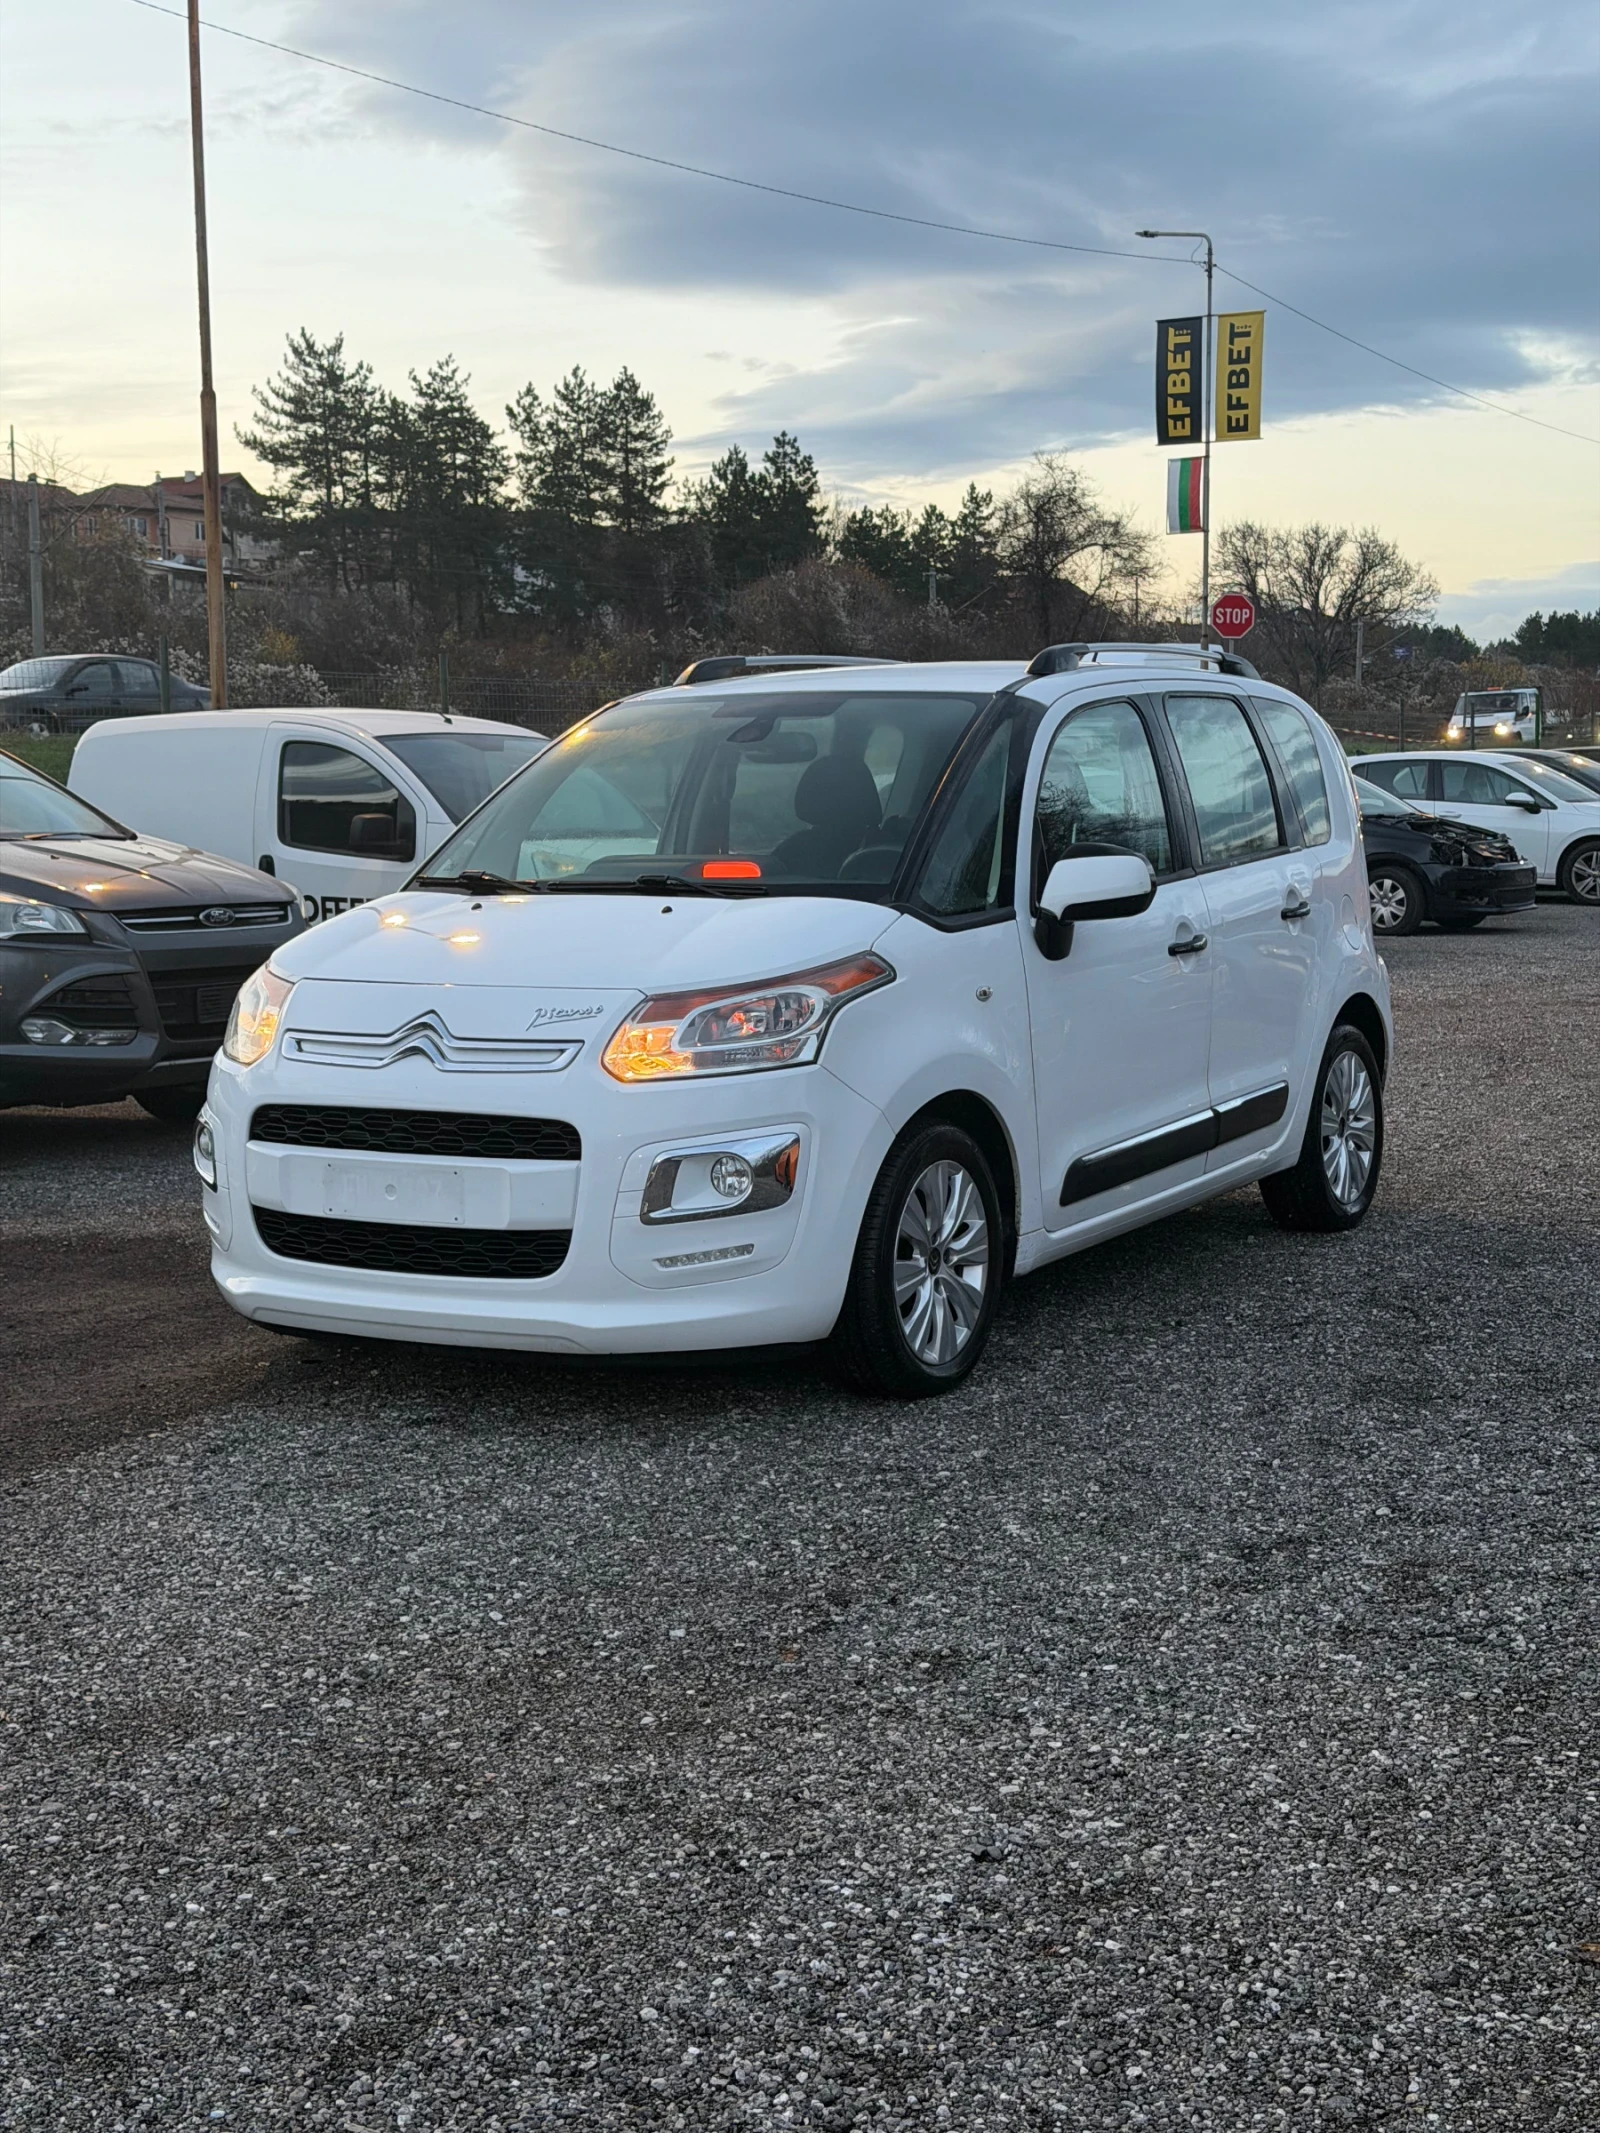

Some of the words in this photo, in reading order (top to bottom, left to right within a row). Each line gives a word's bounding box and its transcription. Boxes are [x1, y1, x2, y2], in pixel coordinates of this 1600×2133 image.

[1167, 327, 1191, 437] EFBET
[1227, 322, 1251, 434] EFBET
[1216, 607, 1250, 624] STOP
